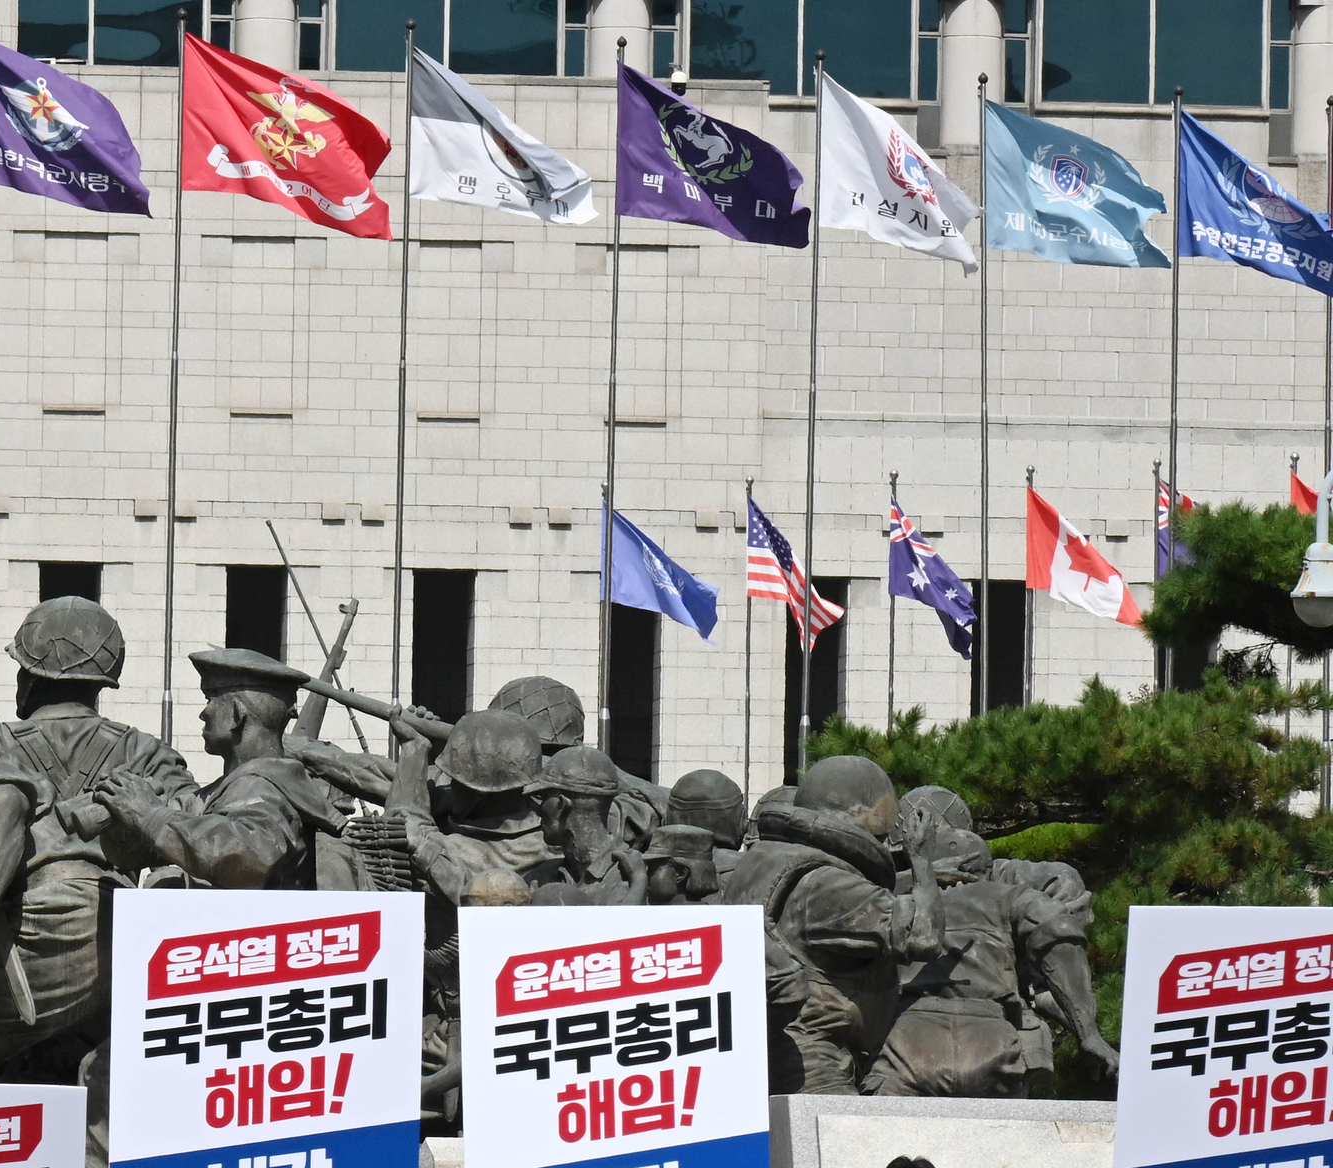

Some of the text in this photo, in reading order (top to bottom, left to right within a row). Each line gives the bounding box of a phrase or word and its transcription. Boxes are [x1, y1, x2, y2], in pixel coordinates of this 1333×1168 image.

[167, 924, 359, 984] 윤석열 정권
[514, 938, 701, 1001] 윤석열 정권
[1178, 945, 1333, 999] 윤석열 정
[144, 979, 388, 1064] 국무총리
[494, 992, 732, 1080] 국무총리
[1151, 1001, 1333, 1076] 국무총
[206, 1054, 353, 1128] 해임!
[558, 1066, 701, 1143] 해임!
[1208, 1066, 1333, 1137] 해임
